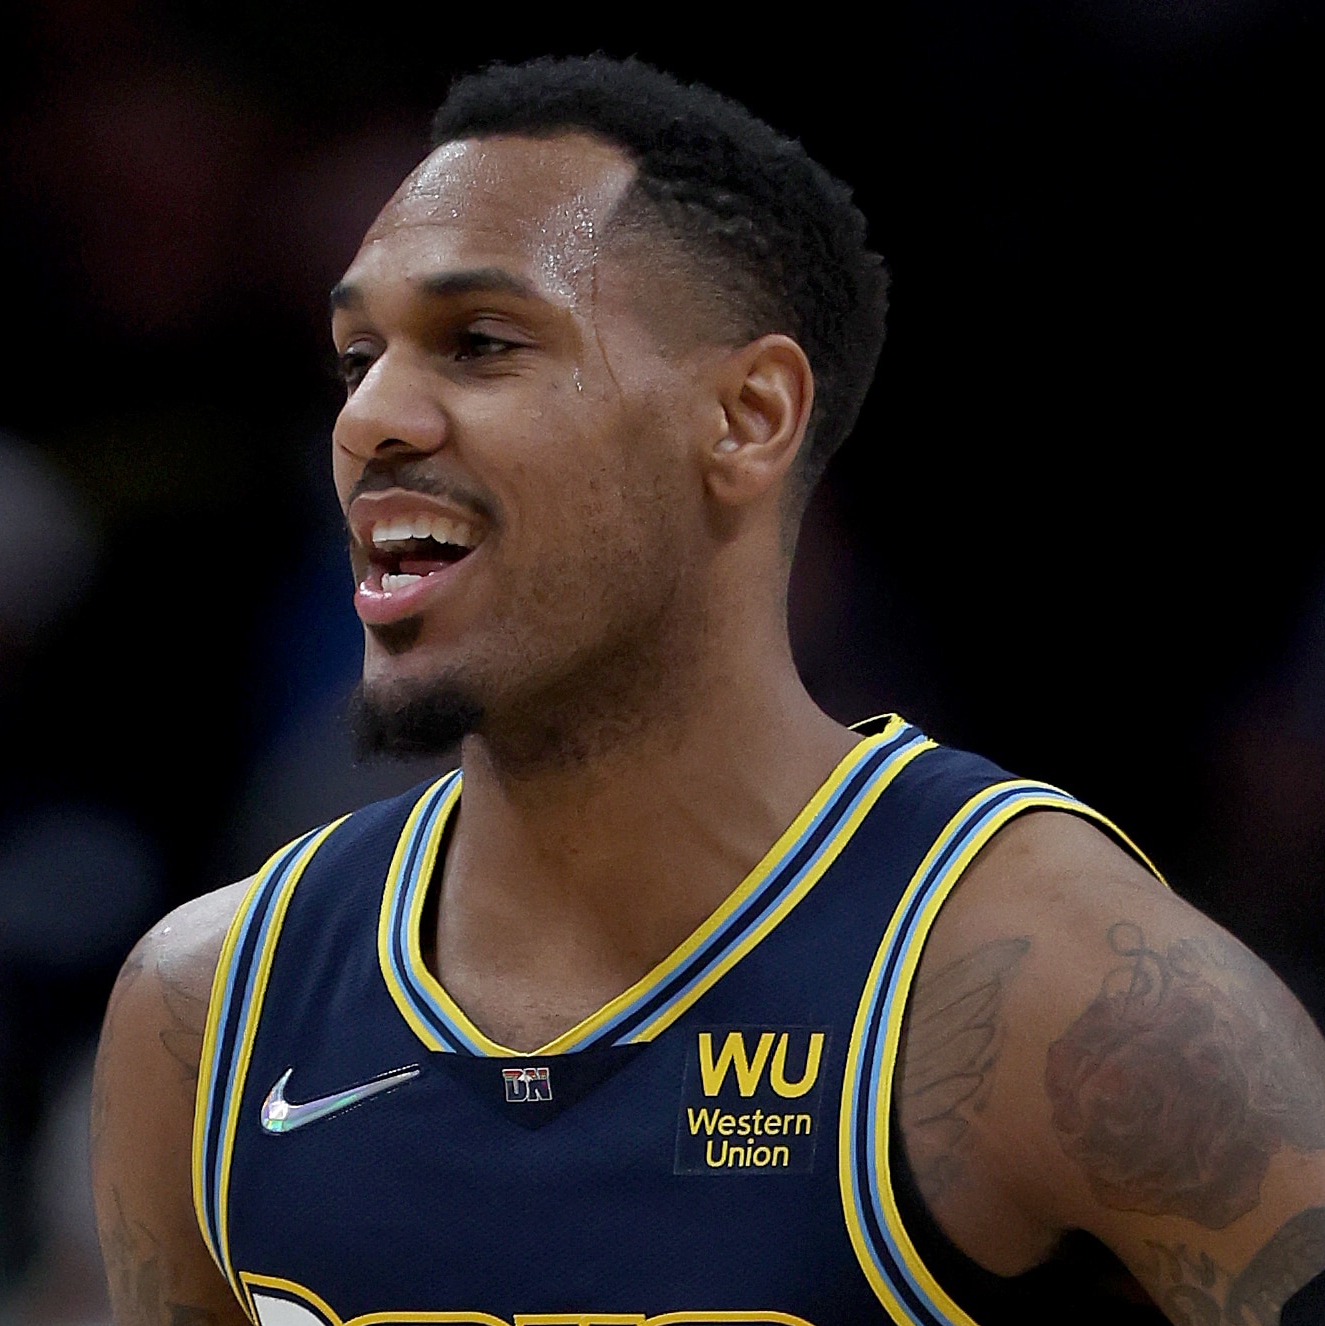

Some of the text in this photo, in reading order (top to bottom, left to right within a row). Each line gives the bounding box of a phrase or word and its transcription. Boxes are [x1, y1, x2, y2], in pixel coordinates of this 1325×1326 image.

[698, 1032, 824, 1098] WU
[687, 1108, 812, 1135] Western
[706, 1138, 789, 1167] Union
